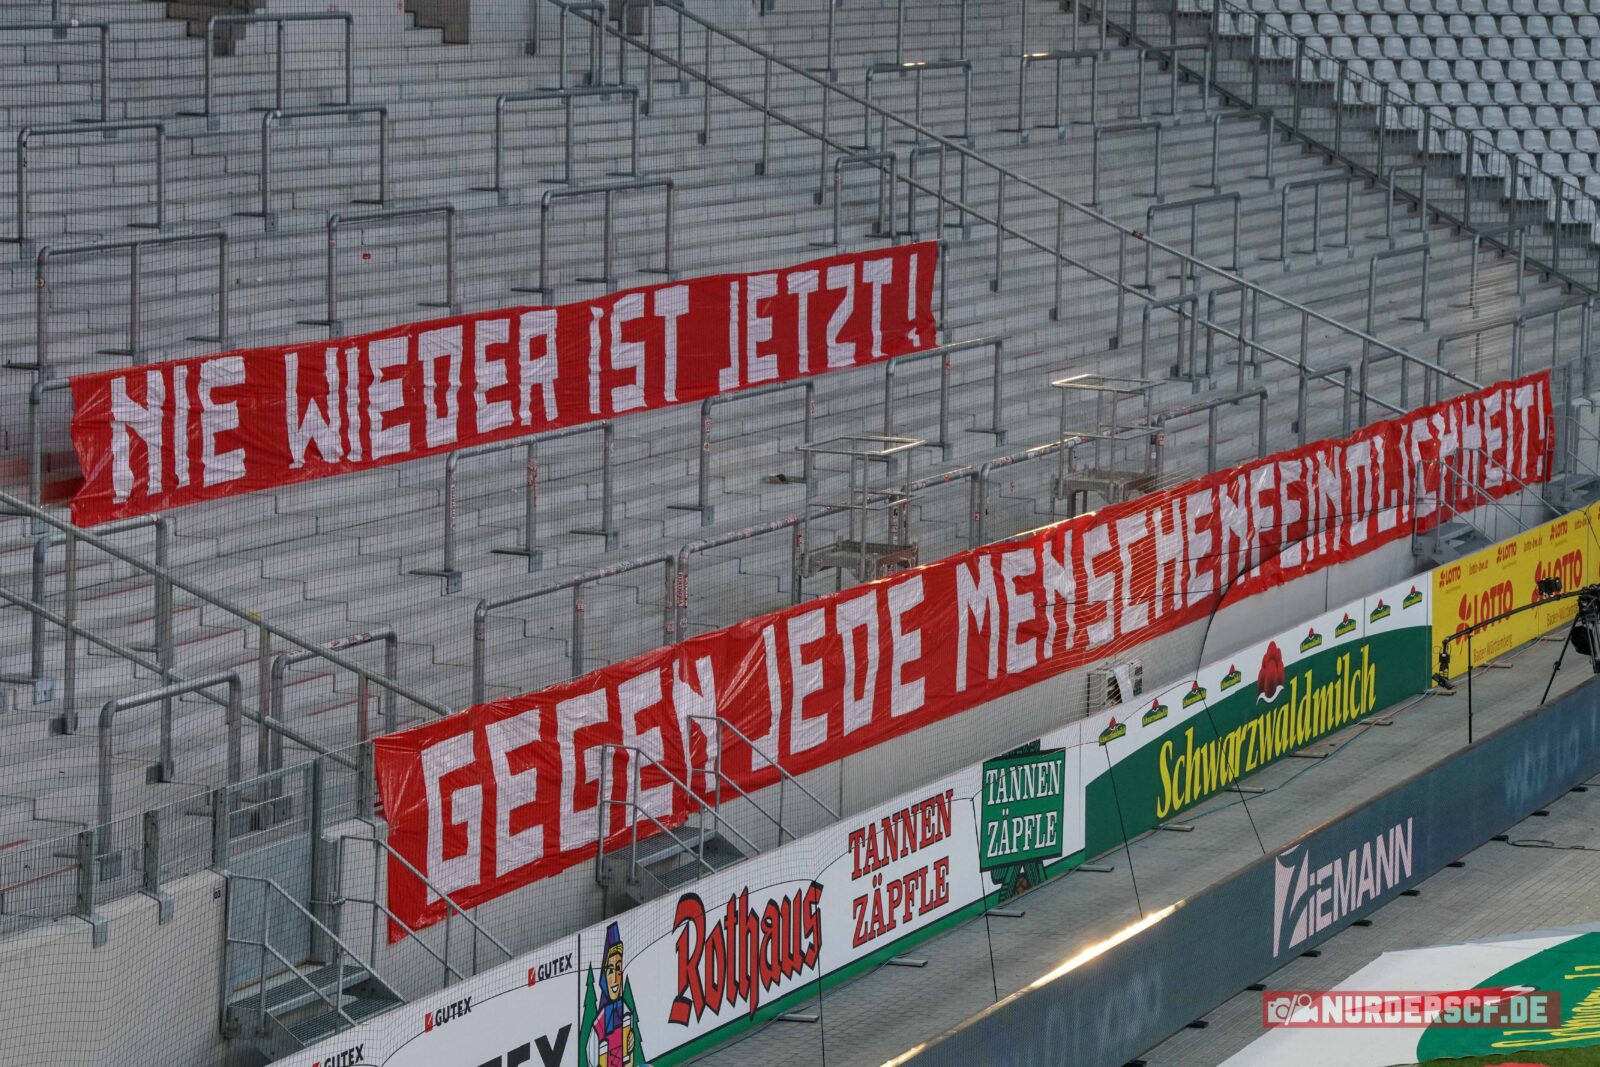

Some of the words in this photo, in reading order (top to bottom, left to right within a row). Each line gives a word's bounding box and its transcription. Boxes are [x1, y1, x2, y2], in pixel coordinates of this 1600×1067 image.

[111, 356, 246, 503] NIE
[284, 309, 559, 469] WIEDER
[589, 285, 690, 414] IST
[719, 253, 921, 392] JETZT!
[1445, 565, 1461, 586] LOTTO
[1502, 542, 1517, 560] LOTTO
[1473, 579, 1514, 635] LOTTO
[421, 655, 718, 906] GEGEN
[752, 574, 927, 771] JEDE
[1156, 644, 1377, 820] Schwarzwaldmilch
[985, 759, 1062, 806] TANNEN
[847, 788, 954, 881] TANNEN
[986, 810, 1058, 859] ZÄPFLE
[851, 855, 950, 950] ZÄPFLE
[537, 952, 574, 982] GUTEX
[667, 880, 824, 1027] Rothaus
[434, 995, 473, 1027] GUTEX
[323, 1043, 365, 1067] GUTEX
